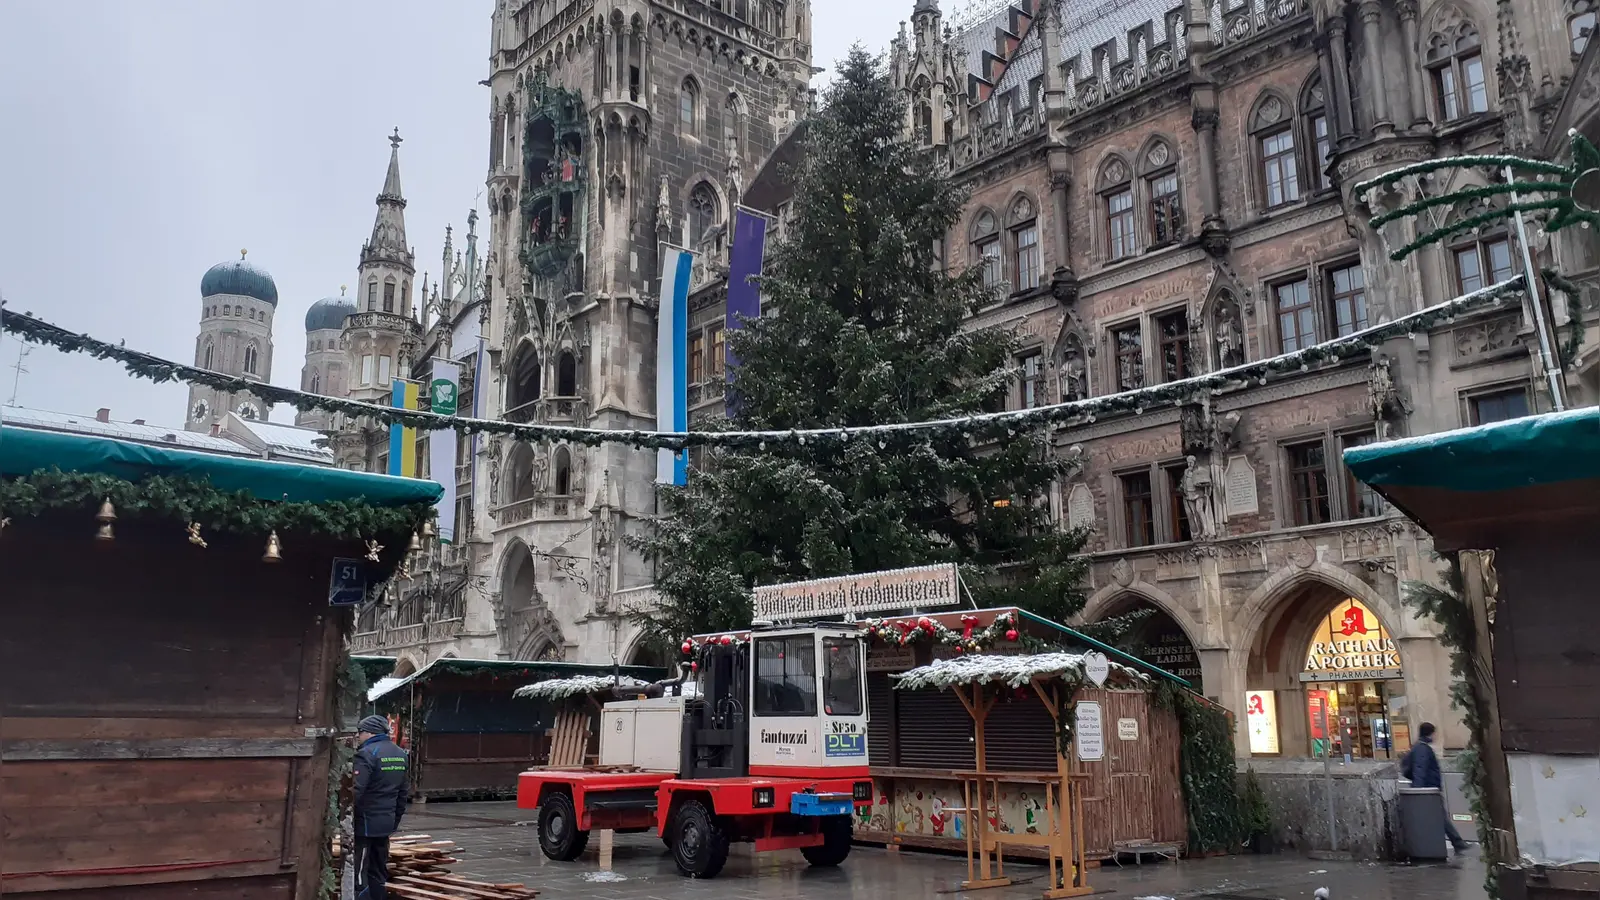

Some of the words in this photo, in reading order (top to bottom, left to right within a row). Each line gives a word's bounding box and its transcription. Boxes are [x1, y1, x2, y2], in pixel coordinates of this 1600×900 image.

[341, 566, 357, 580] 51
[760, 588, 815, 616] Glühwein
[818, 584, 846, 610] nach
[850, 574, 951, 607] Großmutterart
[1143, 645, 1196, 656] BERNSTE
[1314, 638, 1396, 655] RATHAUS
[1156, 654, 1192, 664] LADEN
[1305, 653, 1401, 671] APOTHEK
[1177, 667, 1202, 676] HOUS
[1328, 670, 1384, 680] PHARMACIE
[760, 728, 808, 745] fantuzzi
[829, 734, 860, 748] DLT
